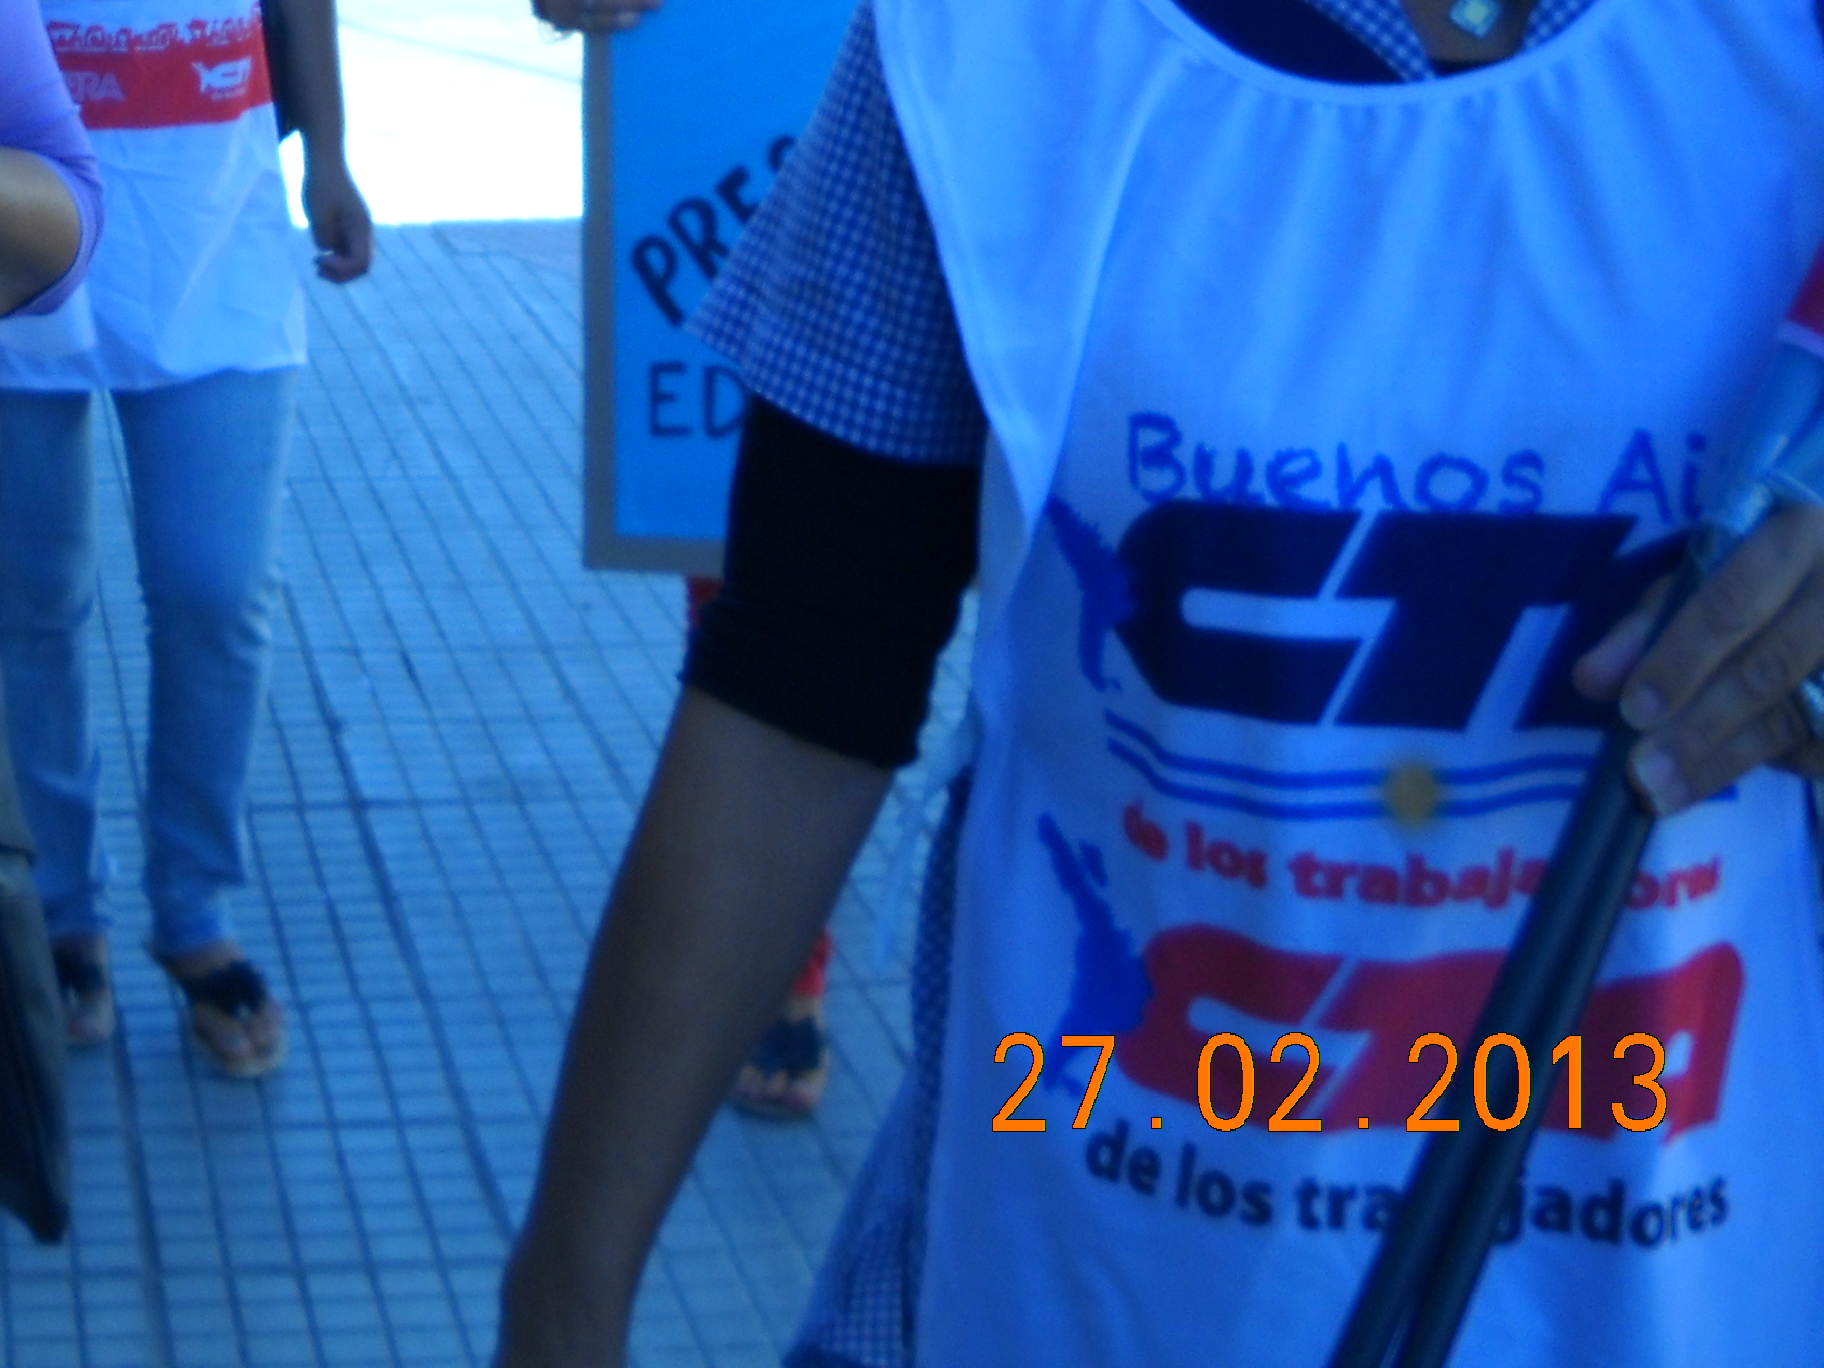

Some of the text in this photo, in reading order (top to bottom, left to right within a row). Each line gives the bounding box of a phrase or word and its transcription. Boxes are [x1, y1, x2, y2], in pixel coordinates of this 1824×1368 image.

[1128, 411, 1546, 514] Buenos
[1185, 821, 1268, 889] los
[1083, 1119, 1162, 1198] de
[1175, 1143, 1273, 1229] los
